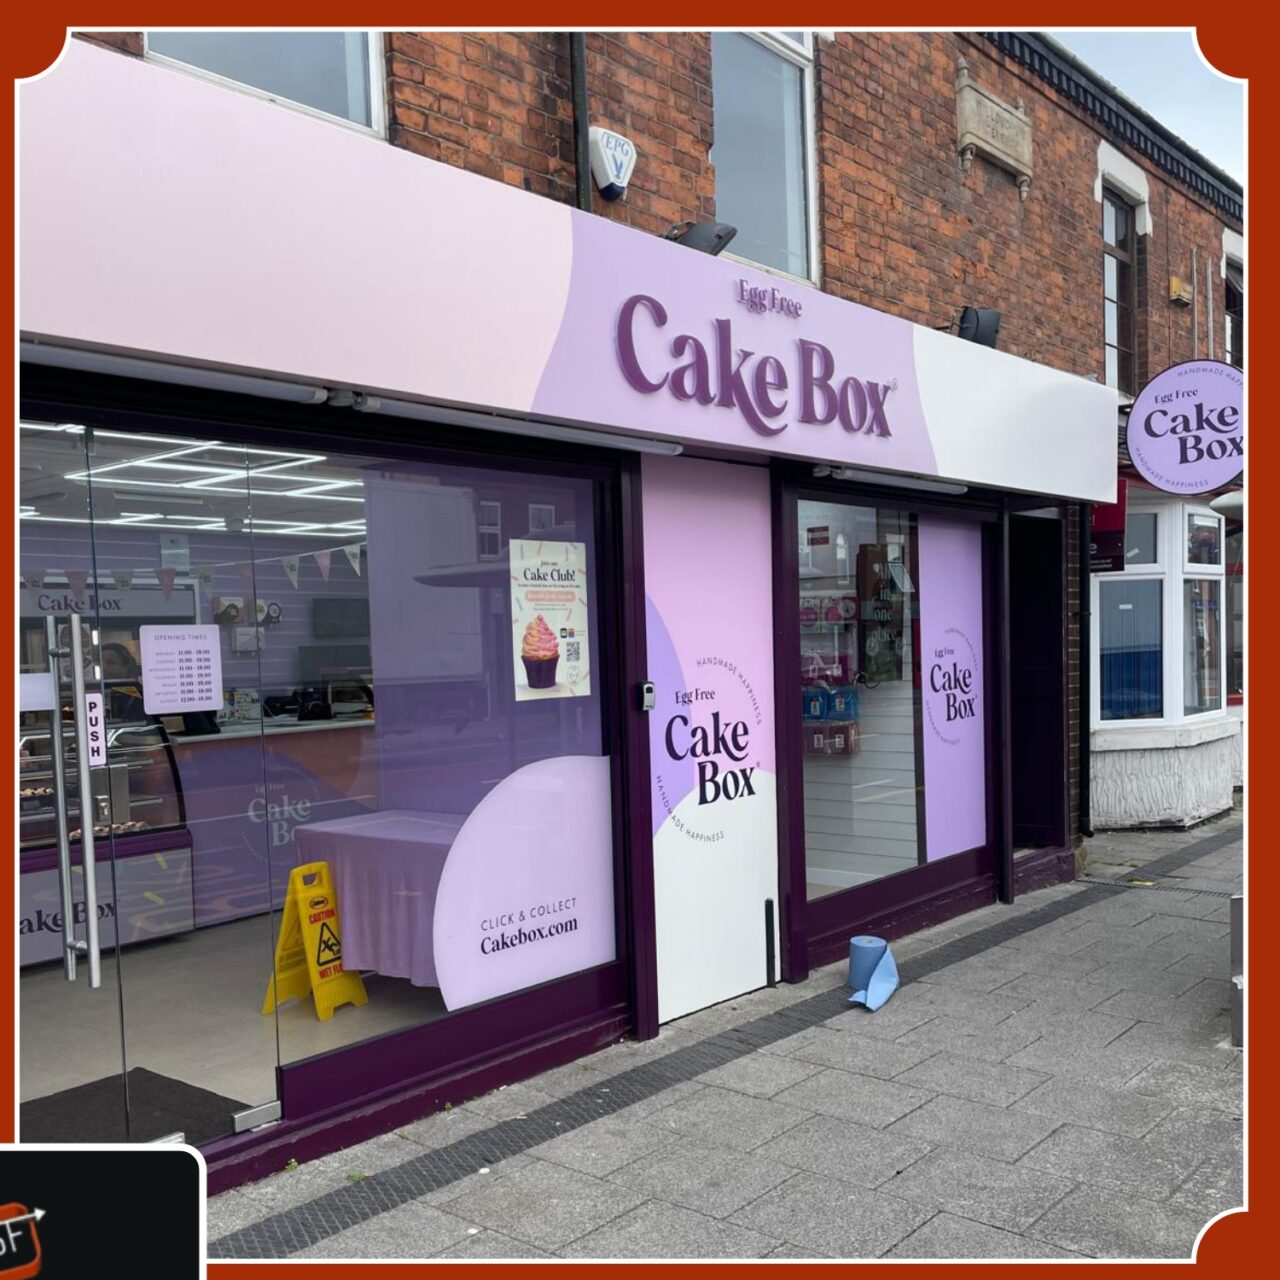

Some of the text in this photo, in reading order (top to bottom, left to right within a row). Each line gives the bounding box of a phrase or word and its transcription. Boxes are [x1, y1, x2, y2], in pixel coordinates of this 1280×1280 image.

[736, 278, 803, 318] Egg Free
[613, 294, 893, 439] Cake Box
[1154, 388, 1199, 405] Egg Free
[1143, 402, 1240, 439] Cake
[1177, 435, 1244, 465] Box
[523, 568, 576, 582] Cake Club!
[37, 594, 85, 614] Cake
[696, 657, 738, 675] HANDMADE
[930, 662, 972, 695] Cake
[674, 687, 716, 706] Egg Free
[945, 692, 976, 722] Box
[88, 701, 101, 757] PUSH
[664, 710, 750, 763] Cake
[697, 760, 756, 806] Box
[247, 795, 312, 823] Cake
[656, 775, 725, 843] HANDMADE HAPPINESS
[19, 909, 63, 935] ake
[480, 897, 577, 932] CLICK & COLLECT
[480, 917, 578, 955] Cakebox.com
